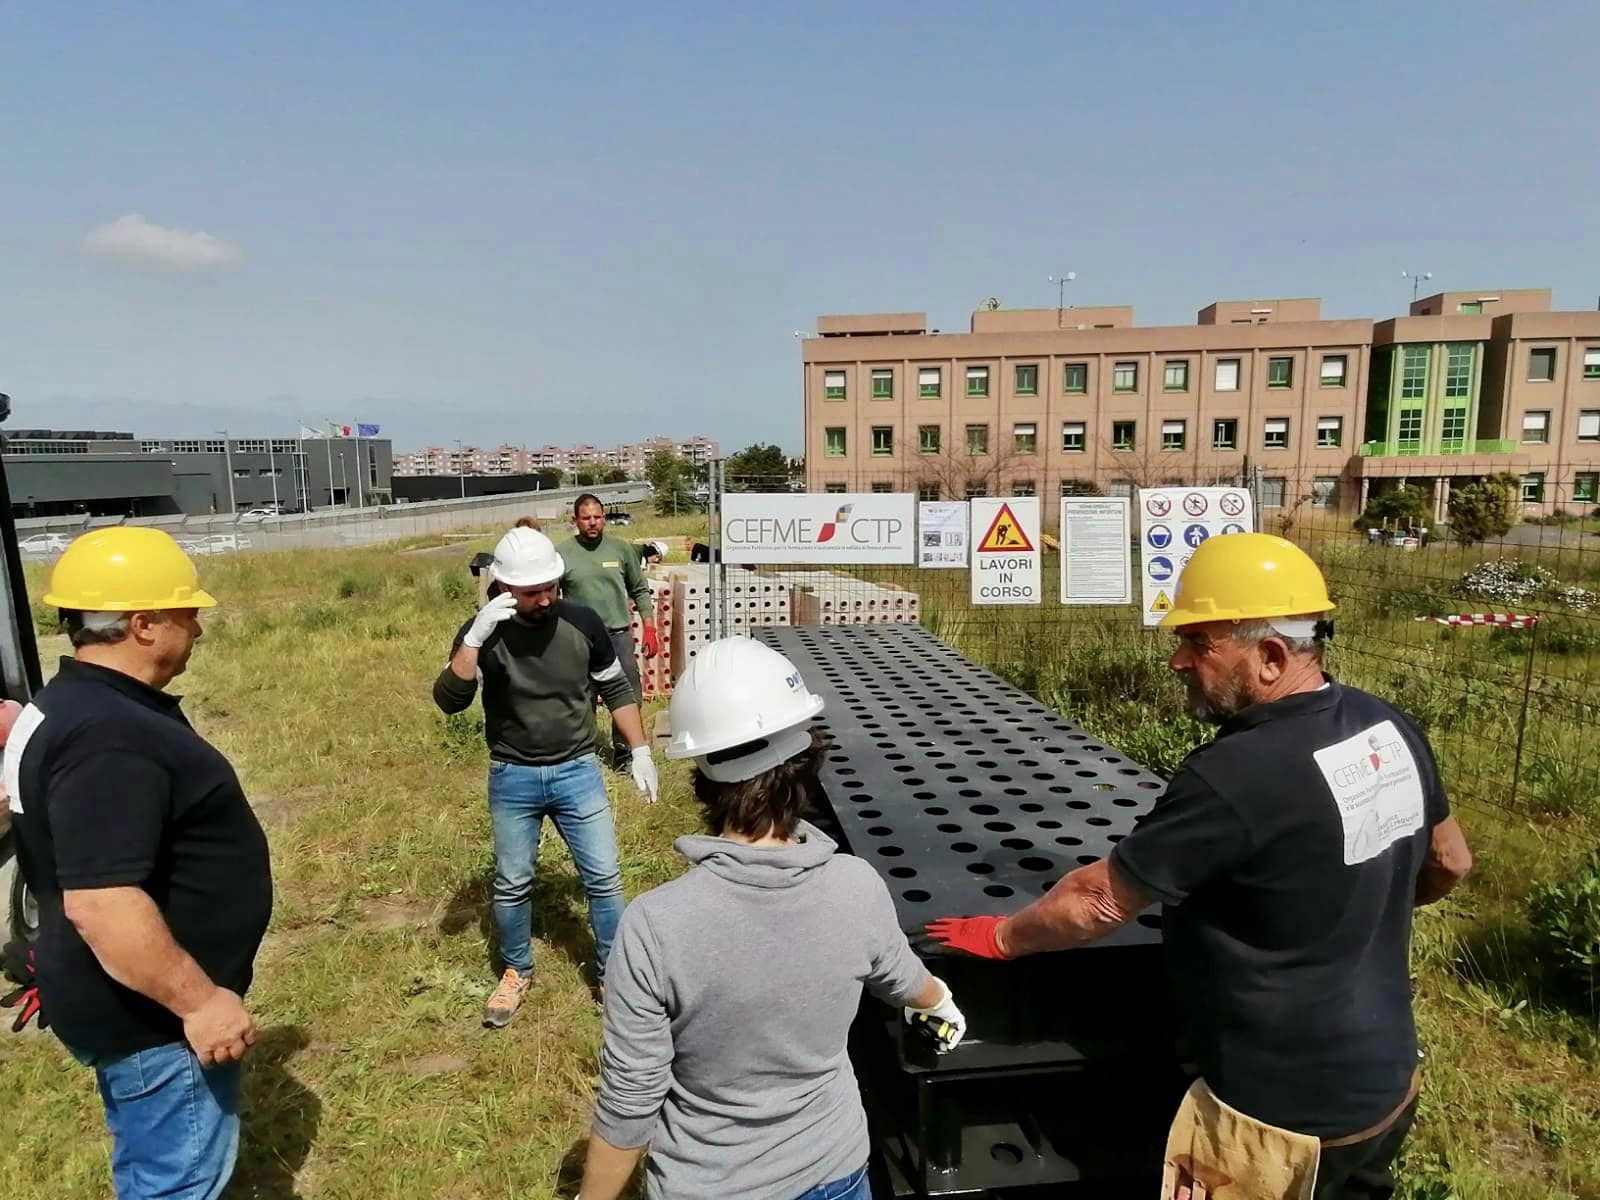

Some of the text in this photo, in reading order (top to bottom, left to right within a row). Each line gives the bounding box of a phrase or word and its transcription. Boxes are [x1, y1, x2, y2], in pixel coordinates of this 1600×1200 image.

[726, 518, 902, 543] CEFME CTP
[980, 559, 1032, 570] LAVORI
[999, 573, 1013, 583] IN
[980, 586, 1032, 597] CORSO
